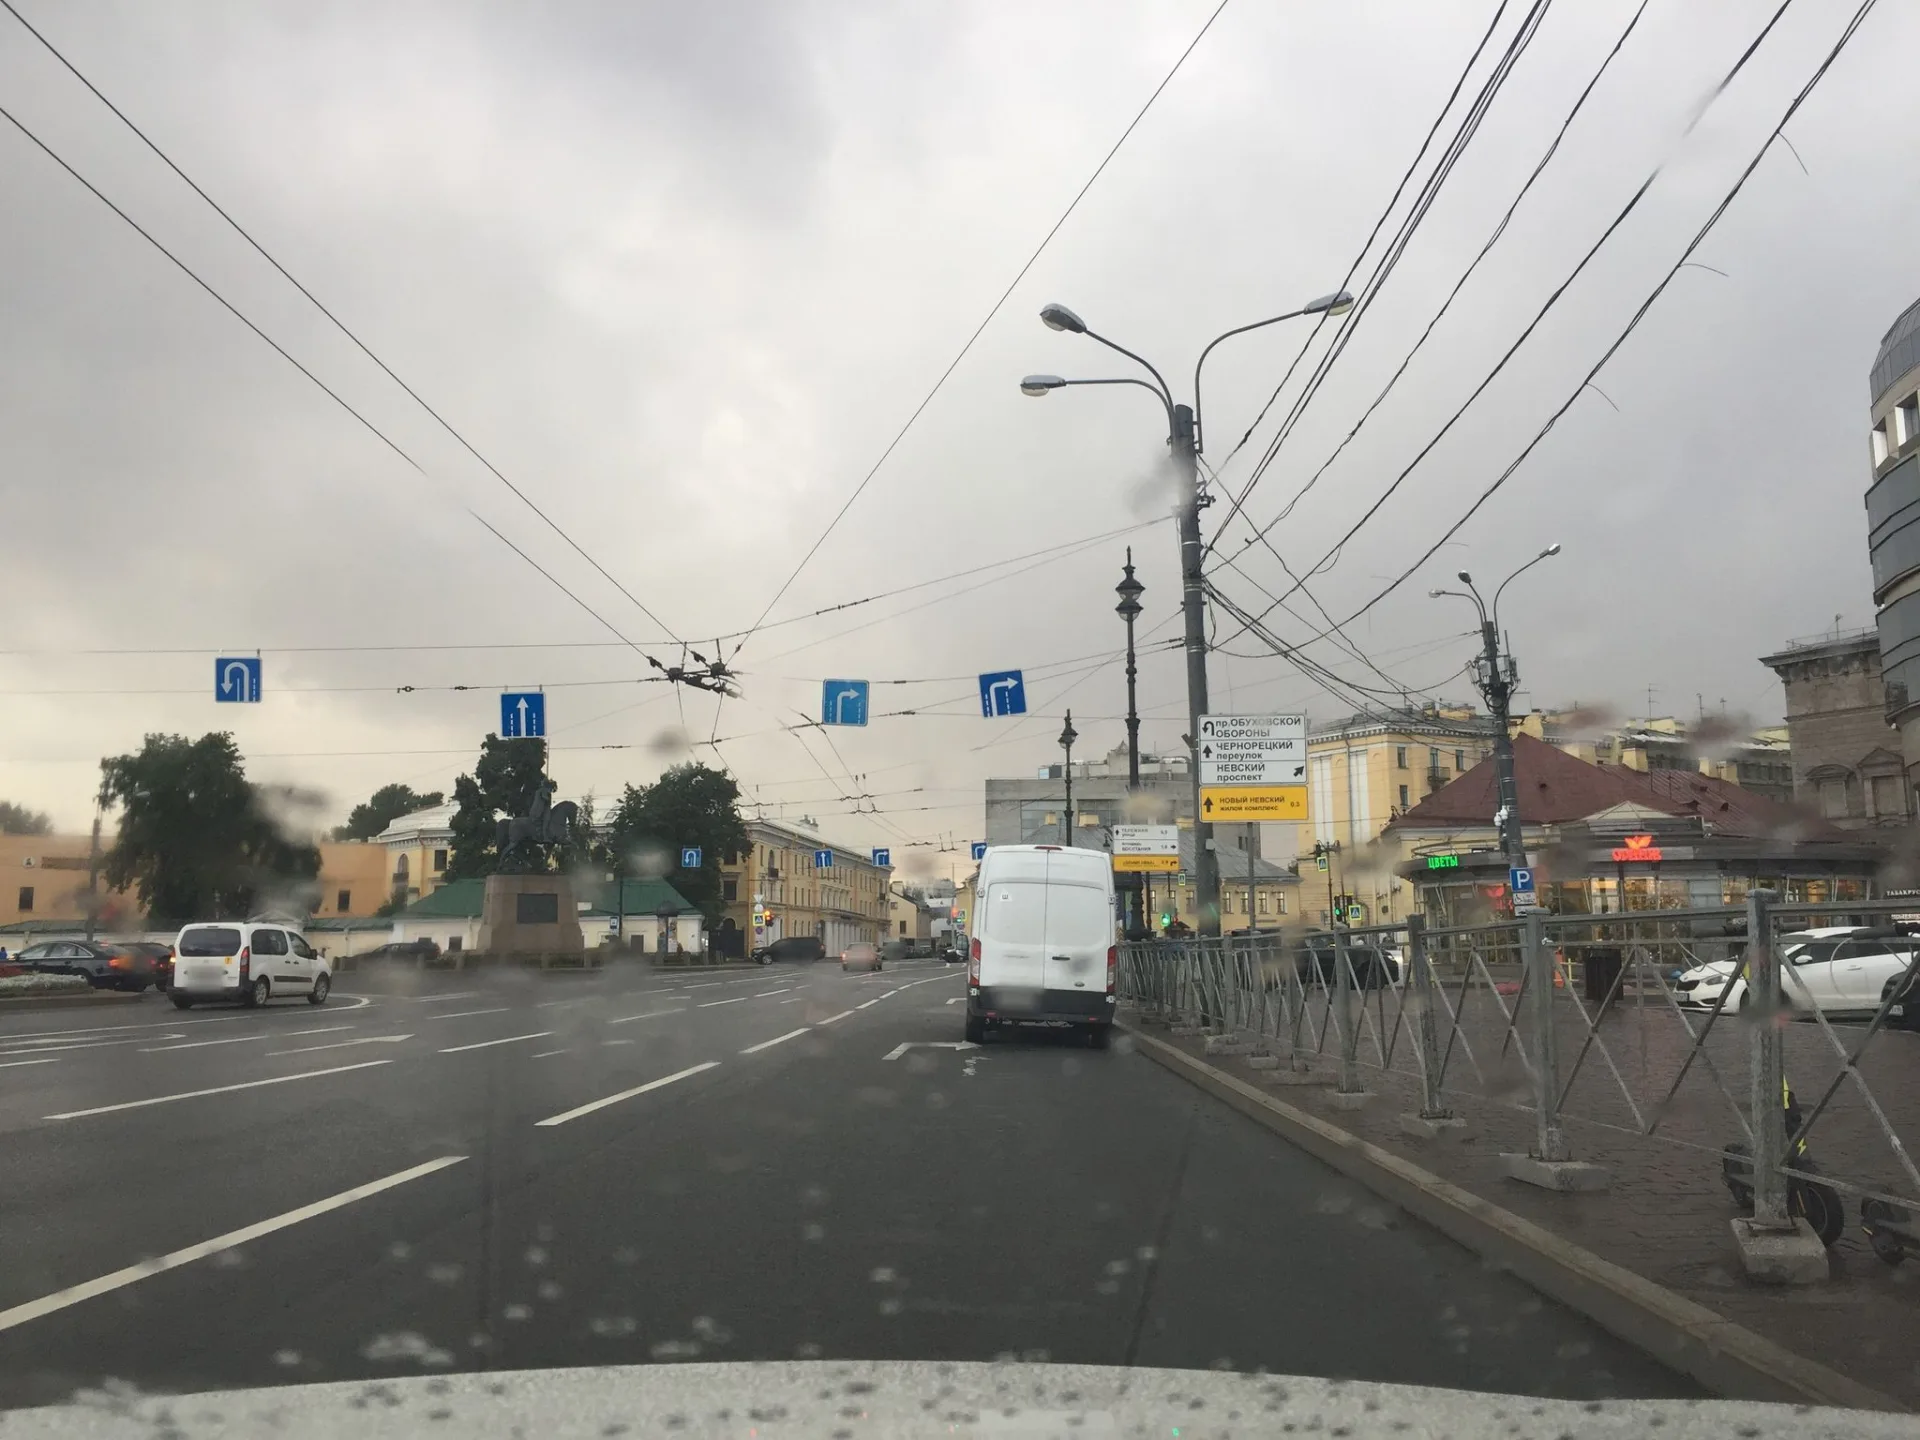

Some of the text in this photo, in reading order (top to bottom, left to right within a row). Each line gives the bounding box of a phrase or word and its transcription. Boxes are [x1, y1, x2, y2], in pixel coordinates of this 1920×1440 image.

[1216, 729, 1270, 738] ОБОРОНЫ
[1216, 740, 1293, 751] ЧЕРНОРЕЦКИЙ
[1216, 752, 1263, 761] переулок
[1217, 762, 1265, 772] НЕВСКИЙ
[1217, 774, 1262, 783] проспект
[1219, 795, 1285, 804] НОВЫЙ НЕВСКИЙ
[1428, 856, 1459, 869] ЦВЕТЫ
